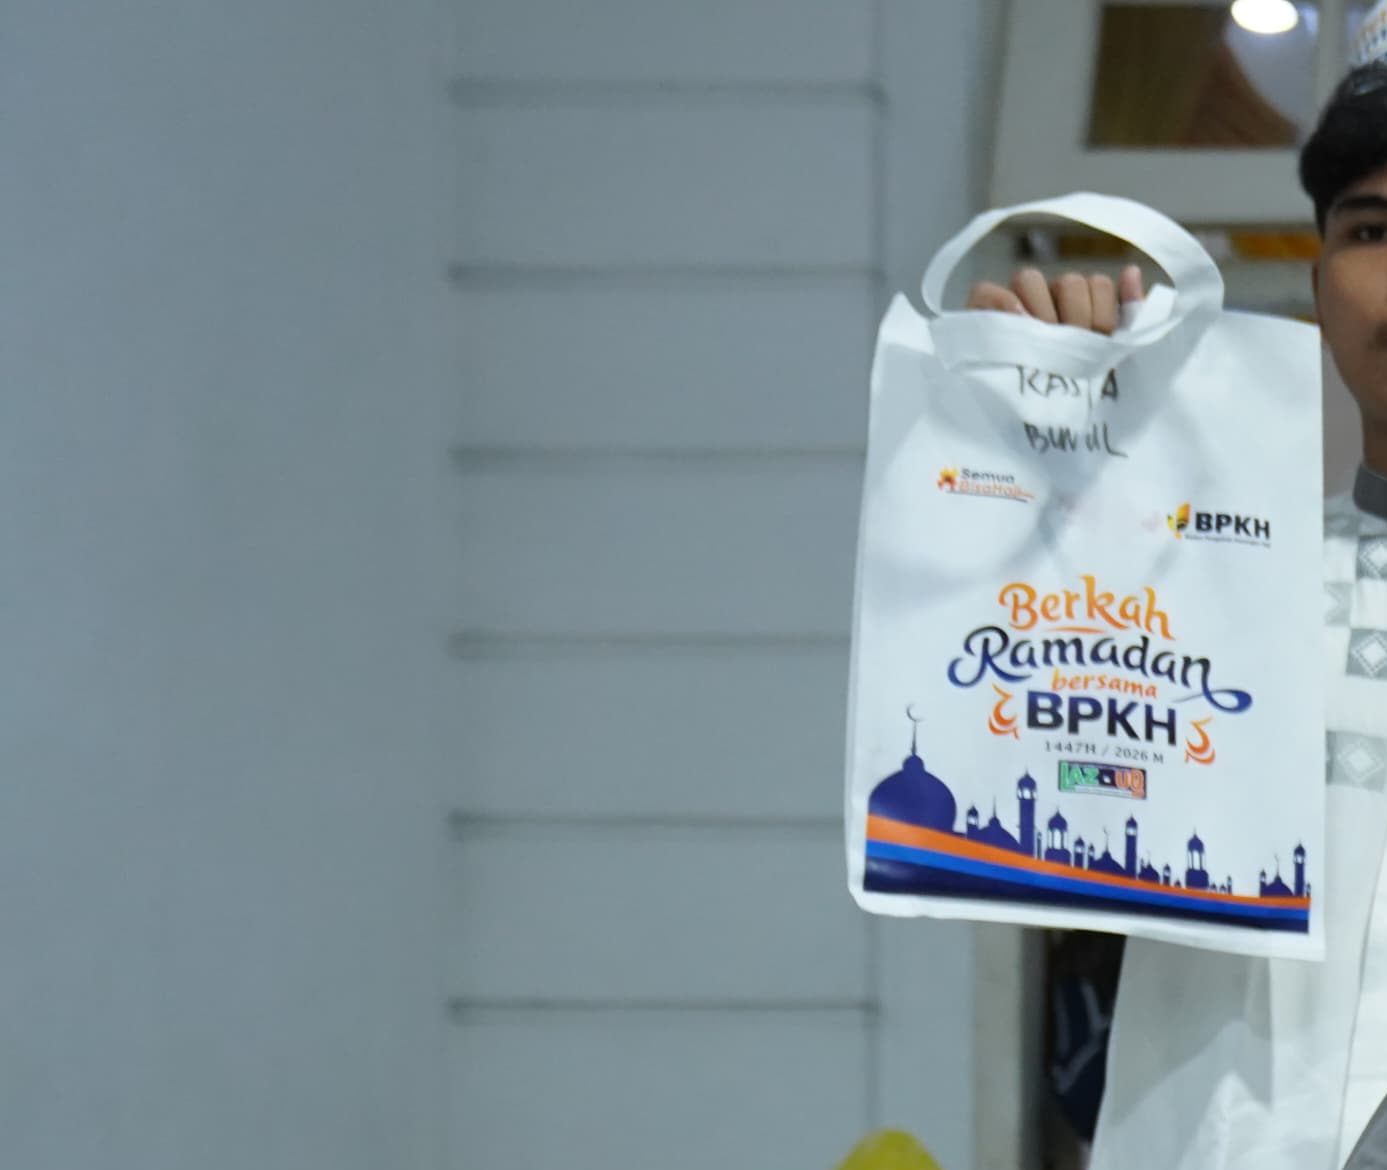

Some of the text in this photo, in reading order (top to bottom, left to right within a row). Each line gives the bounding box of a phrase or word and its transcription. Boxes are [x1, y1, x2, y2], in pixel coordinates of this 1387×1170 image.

[1195, 512, 1270, 540] BPKH
[998, 575, 1175, 640] Berkah
[947, 625, 1253, 714] Ramadan
[1051, 668, 1158, 699] bersama
[1026, 689, 1177, 746] BPKH
[1115, 745, 1148, 761] 2026
[1153, 752, 1164, 764] M
